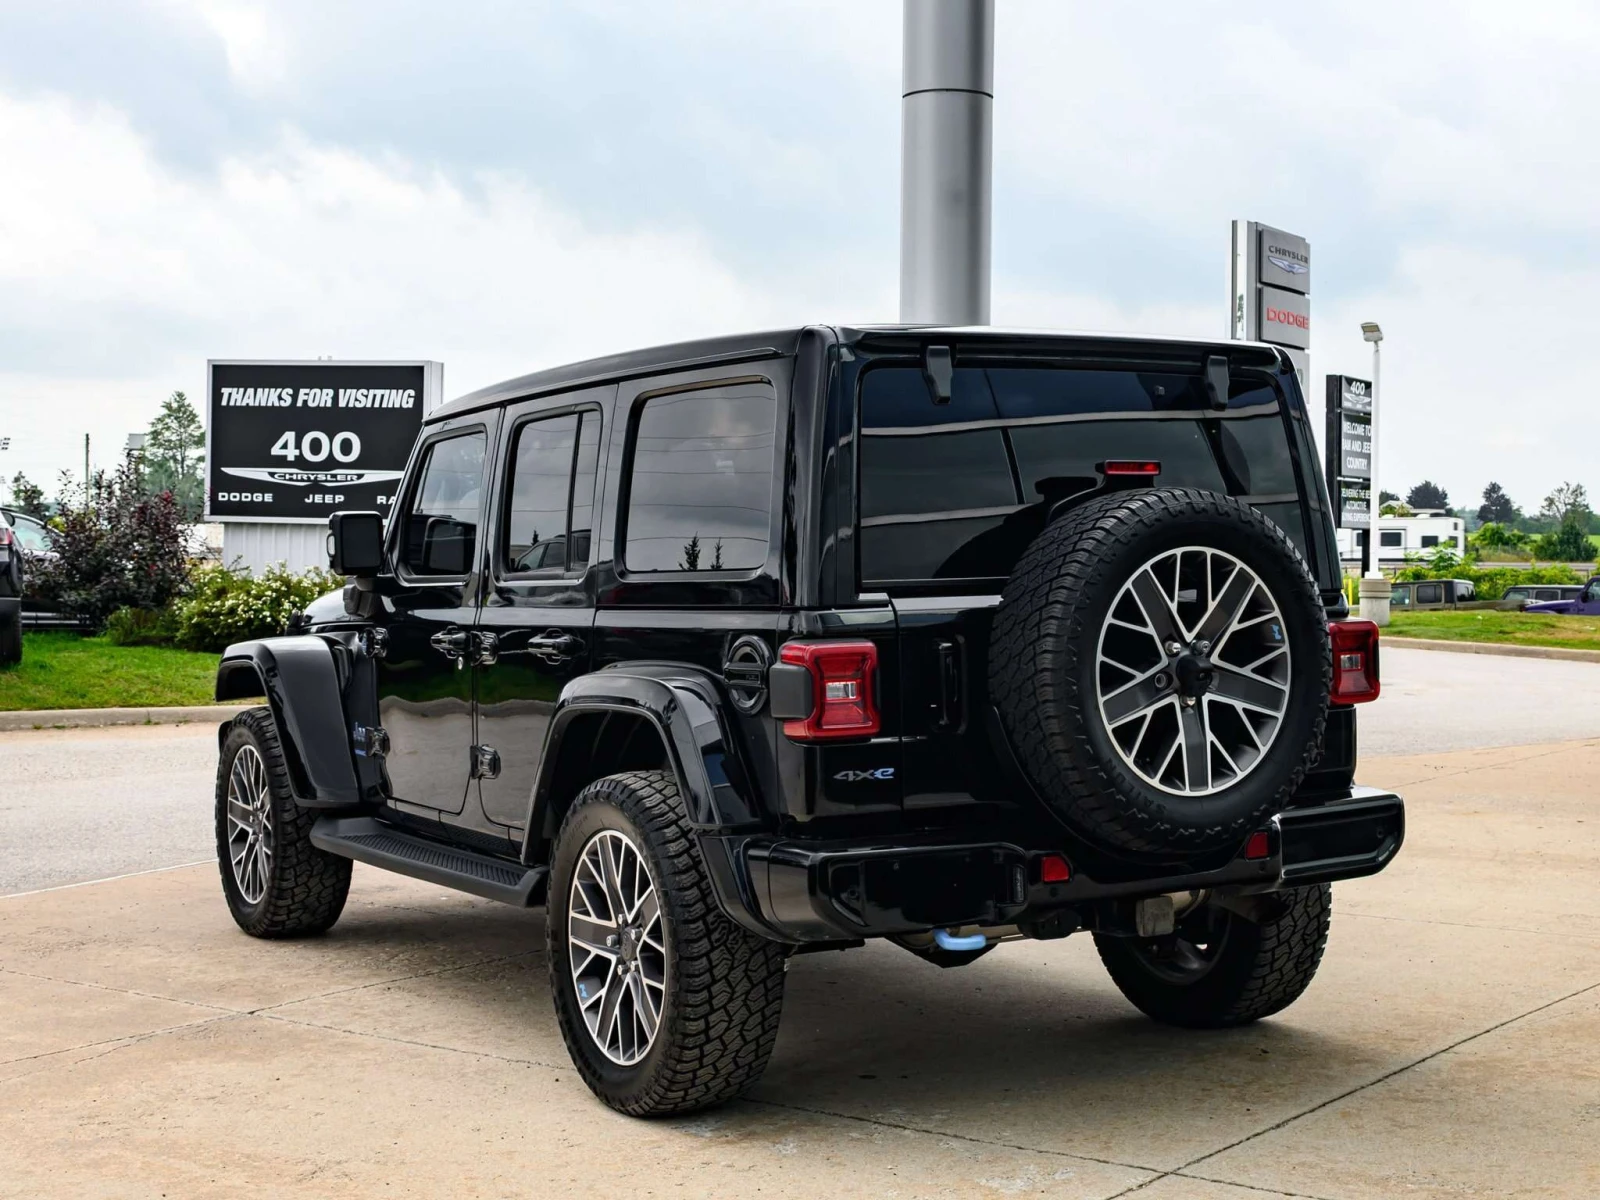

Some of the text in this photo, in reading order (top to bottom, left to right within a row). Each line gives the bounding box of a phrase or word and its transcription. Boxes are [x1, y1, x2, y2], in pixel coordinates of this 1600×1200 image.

[1268, 245, 1308, 264] CHRYSLER
[1266, 307, 1309, 330] DODGE
[1350, 380, 1365, 395] 400
[220, 387, 416, 408] THANKS FOR VISITING
[270, 431, 361, 463] 400
[1362, 441, 1371, 453] JEE
[1346, 456, 1368, 470] COUNTRY
[273, 473, 359, 482] CHRYSLER
[218, 492, 397, 505] DODGE JEEP RA
